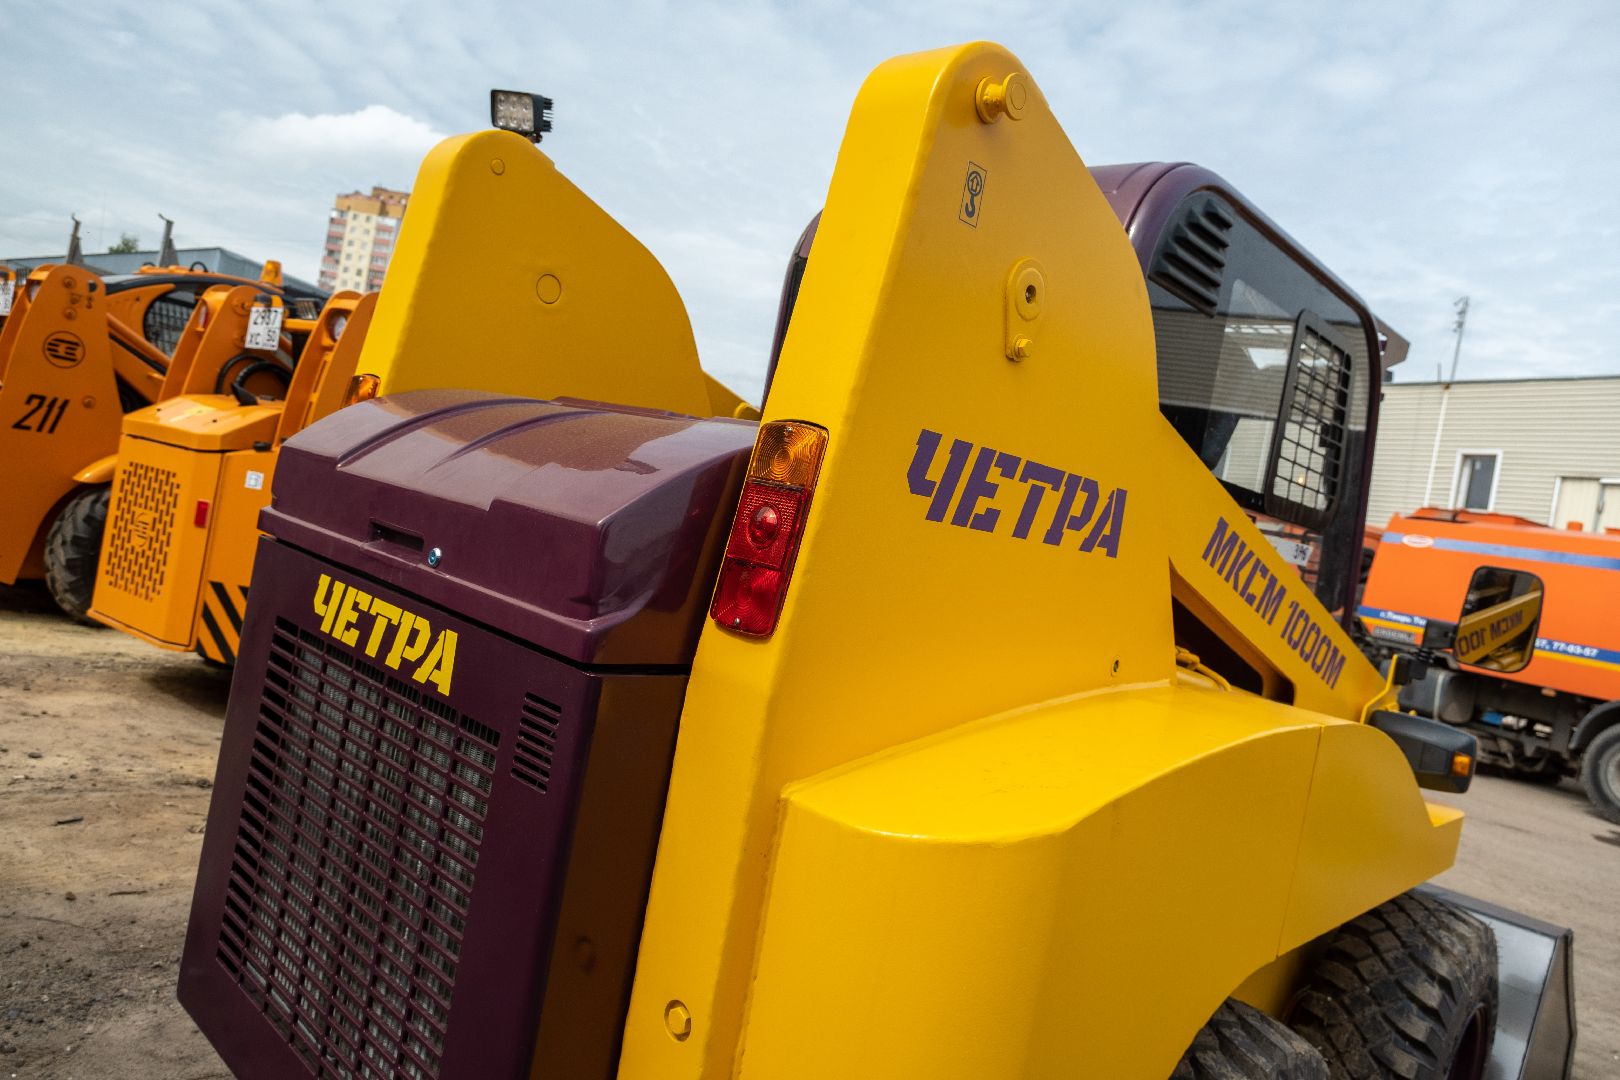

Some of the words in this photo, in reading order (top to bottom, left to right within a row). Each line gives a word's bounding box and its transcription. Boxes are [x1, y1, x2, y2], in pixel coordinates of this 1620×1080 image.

[12, 393, 70, 434] 211
[906, 428, 1128, 558] ЧЕТРА
[313, 573, 458, 697] ЧЕТРА
[1201, 516, 1287, 626] МКСМ
[1280, 600, 1347, 690] 1000М
